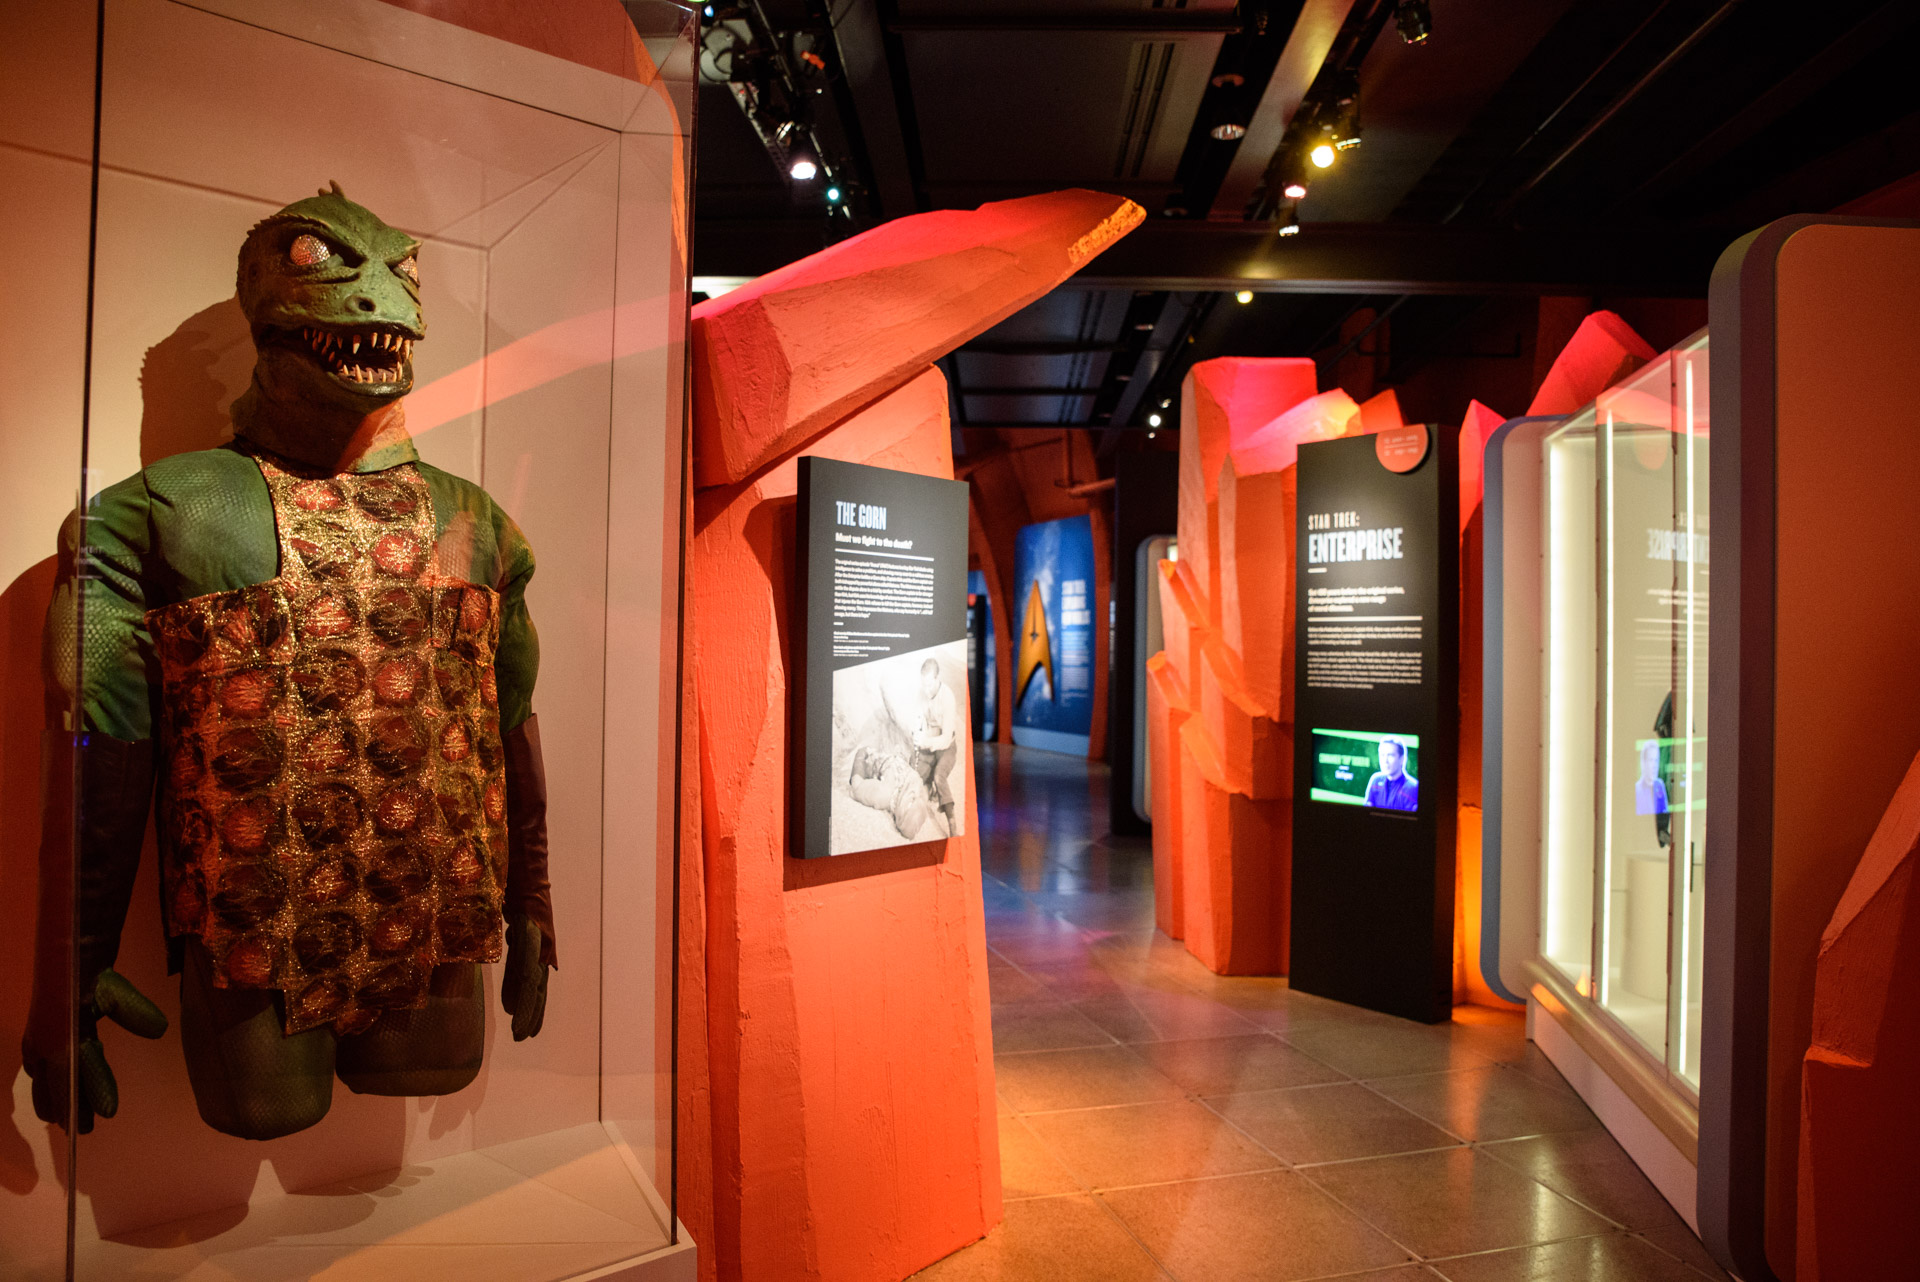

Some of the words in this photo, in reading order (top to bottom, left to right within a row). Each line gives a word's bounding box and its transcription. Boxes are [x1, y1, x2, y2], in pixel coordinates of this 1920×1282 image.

[836, 501, 857, 526] THE
[858, 504, 887, 530] GORN
[1308, 513, 1330, 531] STAR
[1333, 511, 1360, 529] TREK:
[835, 532, 852, 543] Must
[852, 536, 862, 544] we
[862, 535, 876, 547] fight
[876, 538, 884, 546] to
[883, 538, 894, 548] the
[894, 540, 913, 550] death?
[1309, 527, 1403, 563] ENTERPRISE
